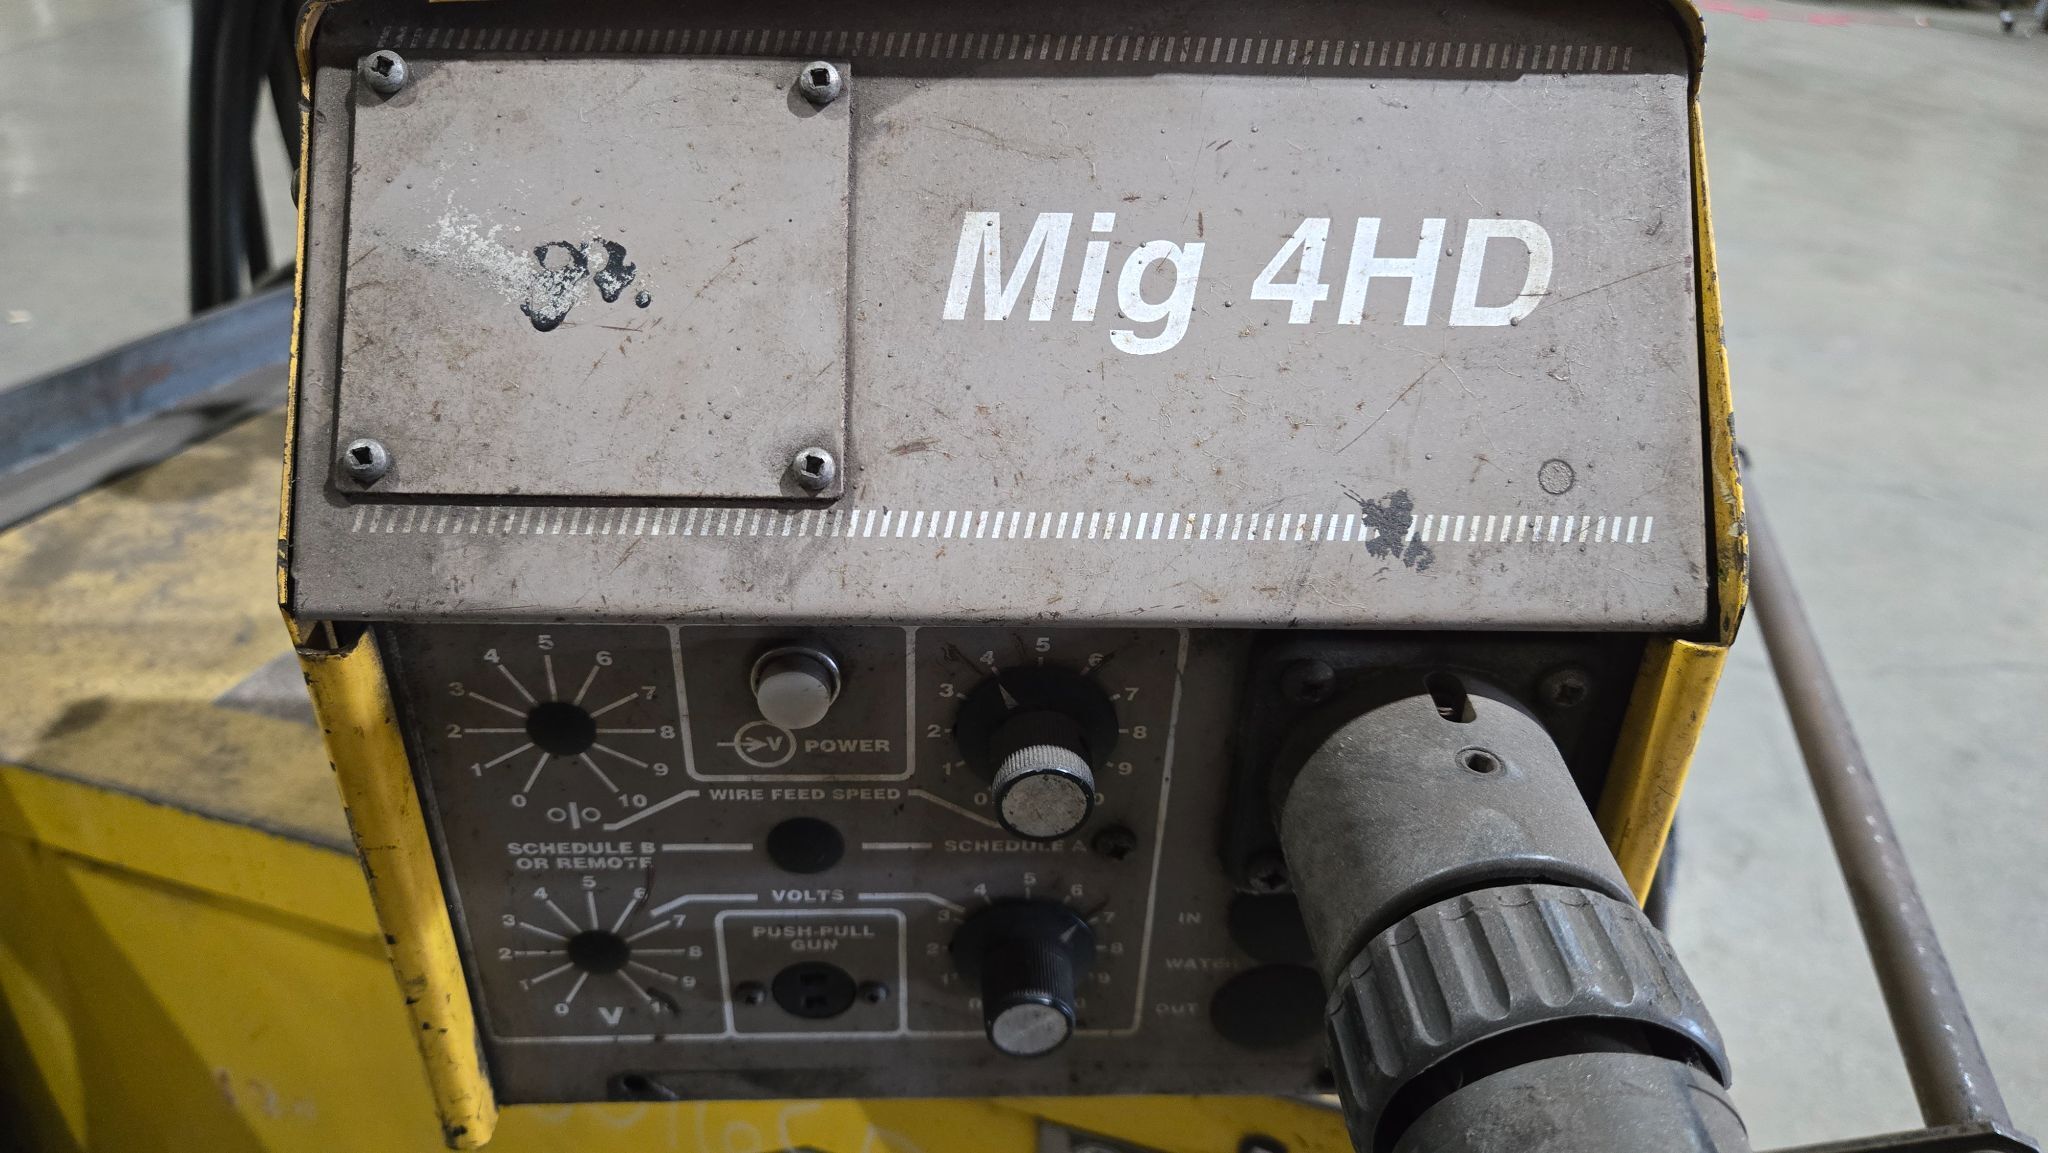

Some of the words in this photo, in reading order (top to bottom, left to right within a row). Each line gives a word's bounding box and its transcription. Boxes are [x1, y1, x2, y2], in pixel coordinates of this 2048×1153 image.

[942, 211, 1205, 356] Mig
[1250, 216, 1554, 327] 4HD
[538, 635, 554, 650] 5
[1036, 638, 1050, 651] 5
[483, 648, 501, 664] 4
[596, 651, 613, 666] 6
[979, 651, 994, 665] 4
[1088, 653, 1103, 666] 6
[449, 682, 465, 697] 3
[641, 685, 656, 700] 7
[939, 684, 954, 698] 3
[1125, 687, 1139, 700] 7
[447, 724, 462, 738] 2
[660, 725, 676, 739] 8
[927, 724, 941, 738] 2
[1132, 726, 1148, 738] 8
[805, 739, 890, 753] POWER
[471, 763, 482, 777] 1
[653, 763, 669, 776] 9
[943, 763, 951, 775] 1
[1118, 762, 1133, 775] 9
[511, 794, 527, 807] 0
[618, 794, 648, 807] 10
[709, 788, 764, 801] WIRE
[771, 788, 825, 801] FEED
[832, 788, 901, 800] SPEED
[974, 793, 987, 805] 0
[507, 842, 633, 855] SCHEDULE
[640, 842, 655, 854] B
[944, 840, 1065, 852] SCHEDULE
[1070, 840, 1087, 851] A
[516, 857, 549, 870] OR
[583, 876, 596, 888] 5
[1023, 872, 1036, 885] 5
[534, 887, 548, 899] 4
[634, 887, 648, 899] 6
[771, 889, 845, 901] VOLTS
[974, 883, 987, 895] 4
[1071, 884, 1083, 895] 6
[502, 914, 516, 927] 3
[673, 914, 686, 927] 7
[938, 910, 950, 922] 3
[1104, 911, 1115, 923] 7
[1178, 912, 1201, 924] IN
[752, 926, 876, 938] PUSH-PULL
[791, 939, 838, 950] GUN
[926, 943, 939, 955] 2
[1110, 942, 1123, 953] 8
[499, 948, 512, 960] 2
[688, 946, 702, 957] 8
[519, 979, 529, 990] 1
[682, 976, 696, 988] 9
[941, 974, 949, 985] 1
[1098, 973, 1110, 984] 9
[555, 1003, 569, 1015] 0
[1155, 1002, 1199, 1015] OUT
[598, 1007, 624, 1025] V
